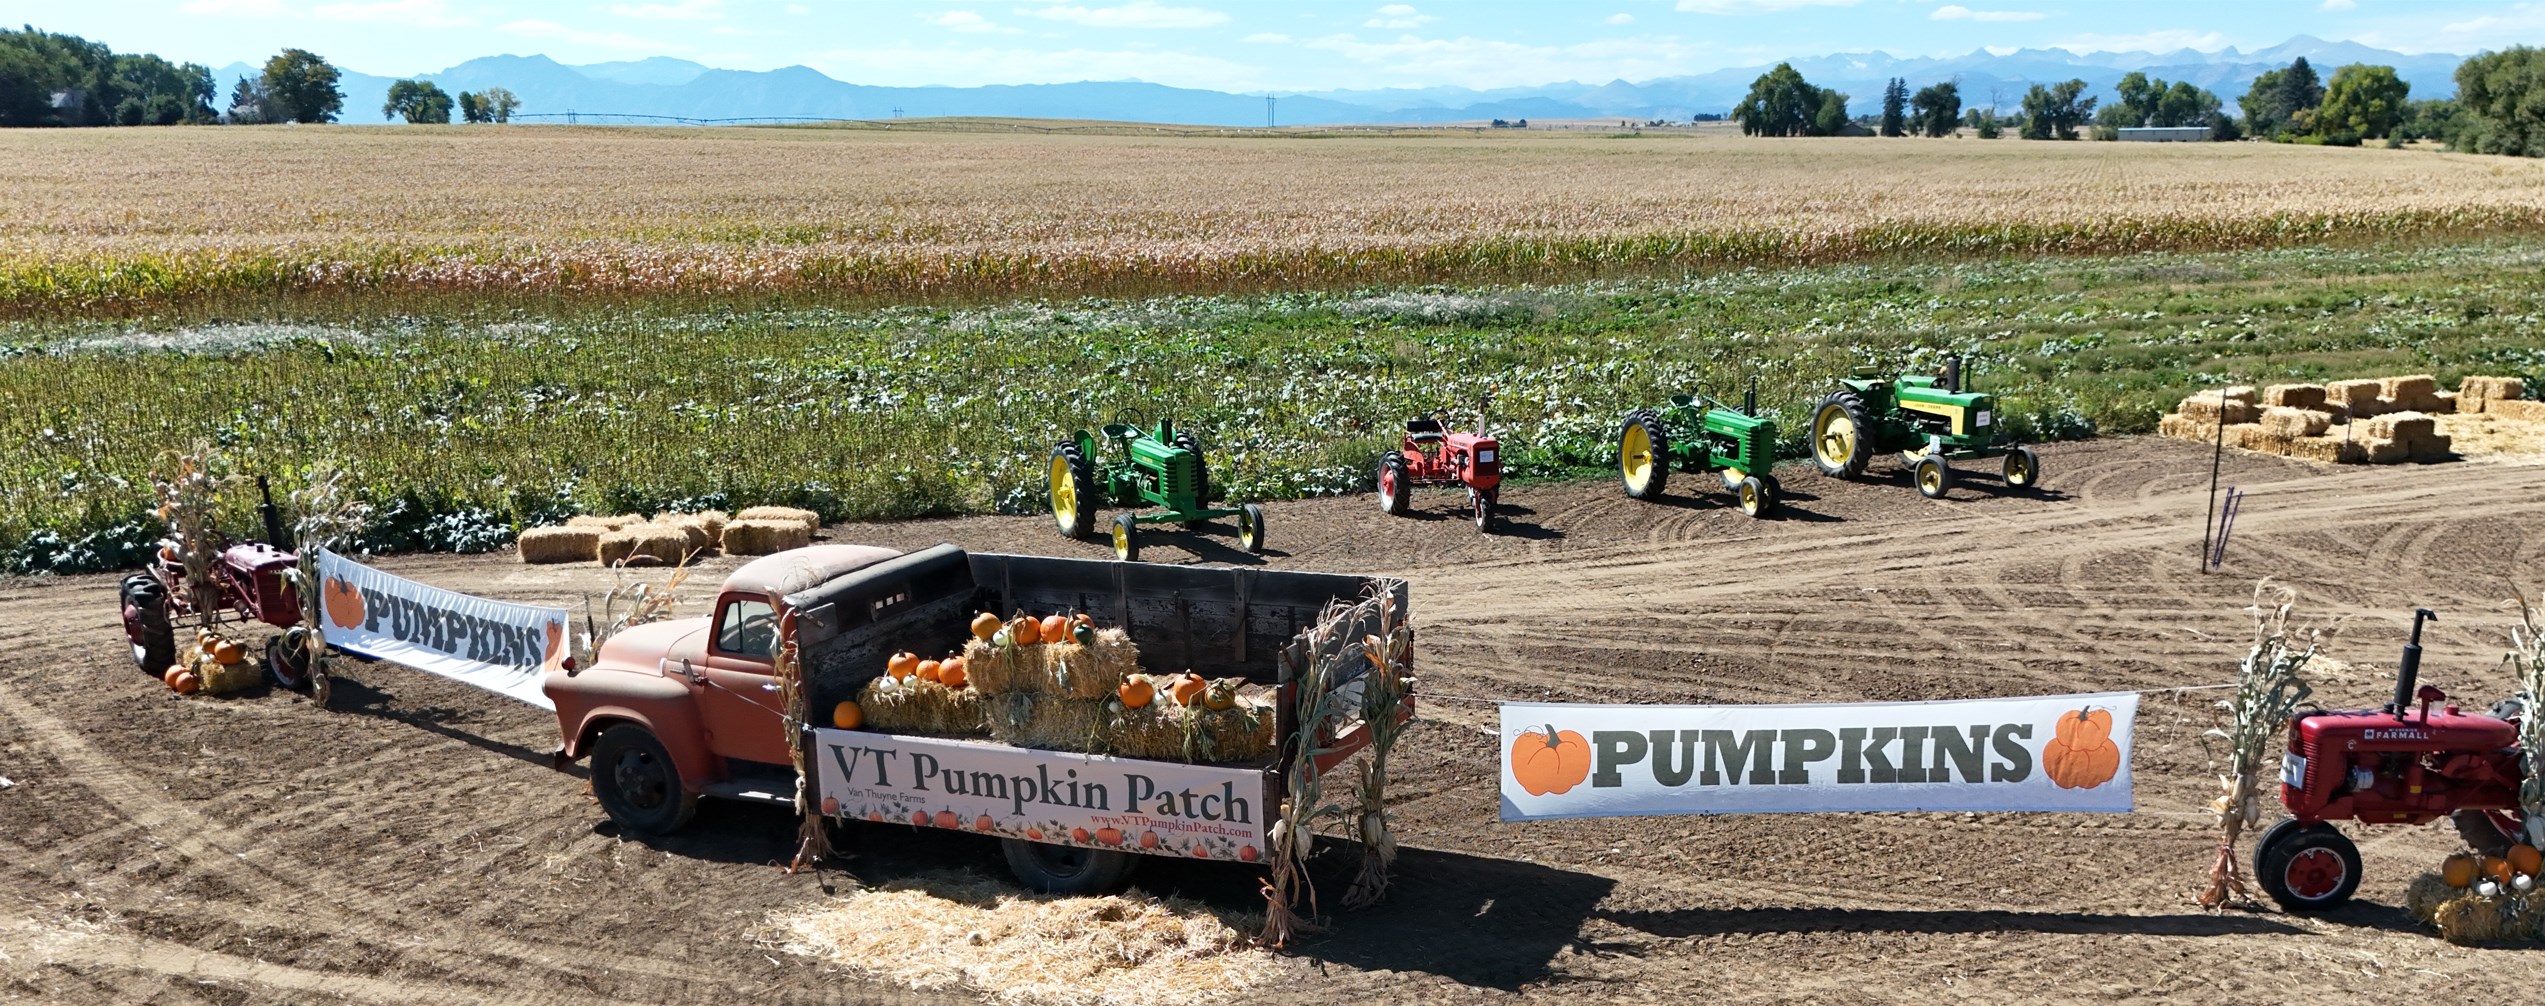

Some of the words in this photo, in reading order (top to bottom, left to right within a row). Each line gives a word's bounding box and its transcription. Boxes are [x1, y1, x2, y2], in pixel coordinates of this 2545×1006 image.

[361, 587, 541, 670] PUMPKINS
[1592, 723, 2033, 788] PUMPKINS
[2376, 731, 2429, 740] FARMALL
[828, 744, 897, 787] VT
[909, 752, 1111, 817] Pumpkin
[1123, 773, 1252, 825] Patch
[847, 786, 864, 799] Van
[865, 788, 898, 803] Thuyne
[900, 791, 926, 805] Farms
[1090, 814, 1253, 839] www.VTPumpkinPatch.com
